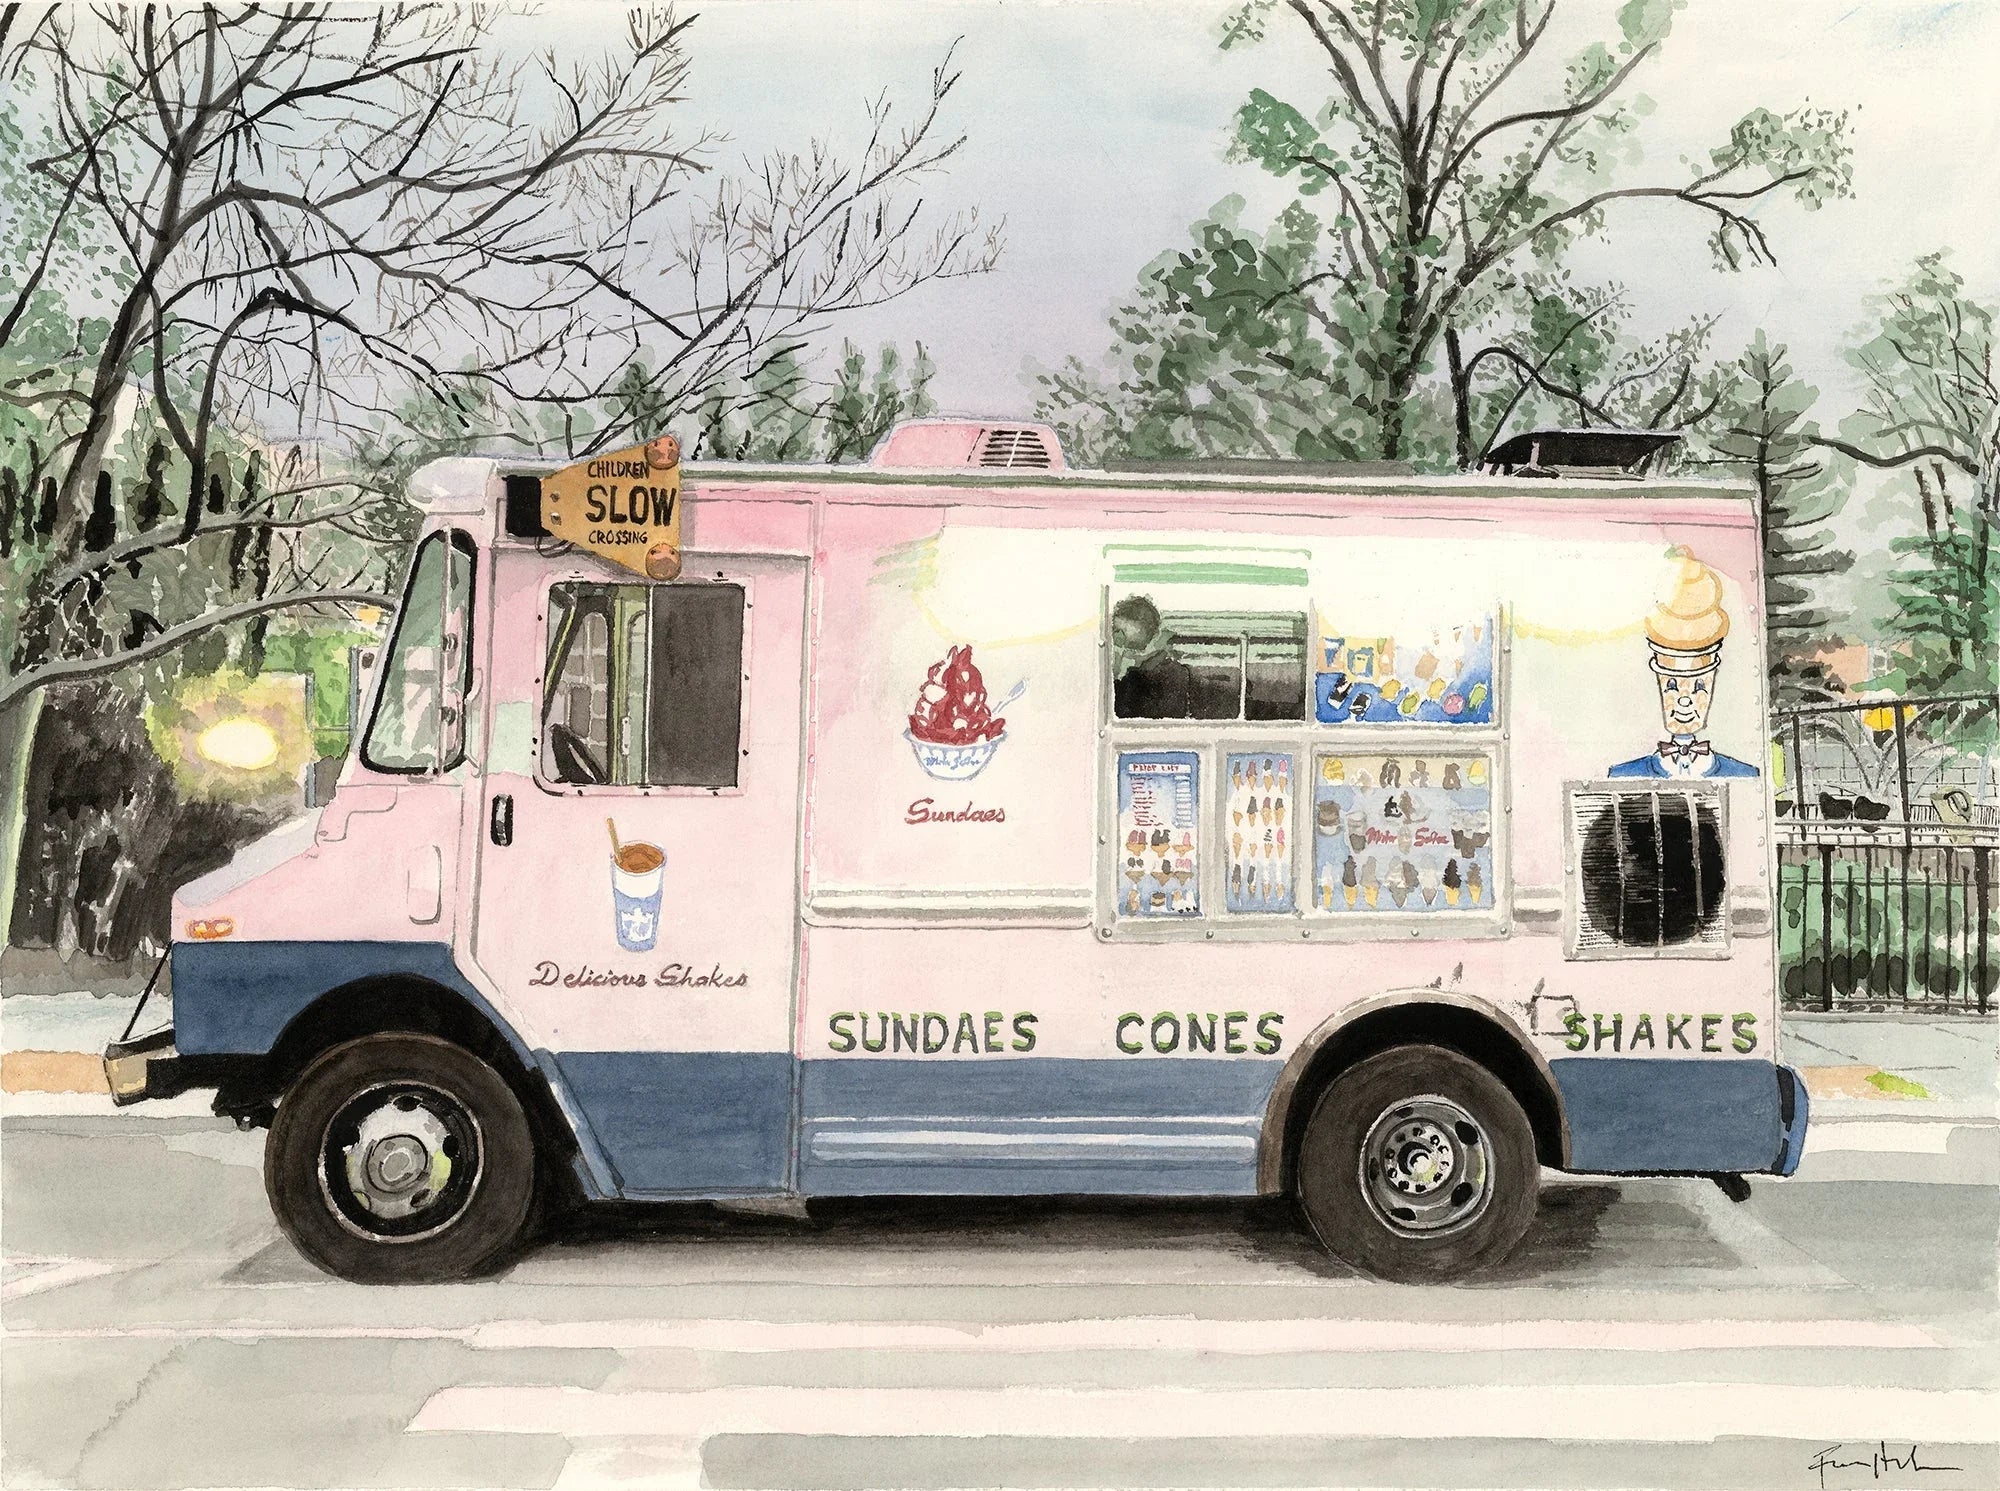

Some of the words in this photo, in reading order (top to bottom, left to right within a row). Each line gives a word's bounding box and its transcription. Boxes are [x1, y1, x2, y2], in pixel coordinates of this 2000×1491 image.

[587, 461, 649, 479] CHILDREN
[585, 485, 677, 526] SLOW
[588, 530, 648, 545] CROSSING
[904, 797, 1006, 825] Sundaes
[528, 960, 648, 989] Delicious
[653, 962, 749, 989] Shakes
[828, 1011, 1039, 1055] SUNDAES
[1115, 1010, 1285, 1055] CONES
[1562, 1012, 1758, 1054] SHAKES
